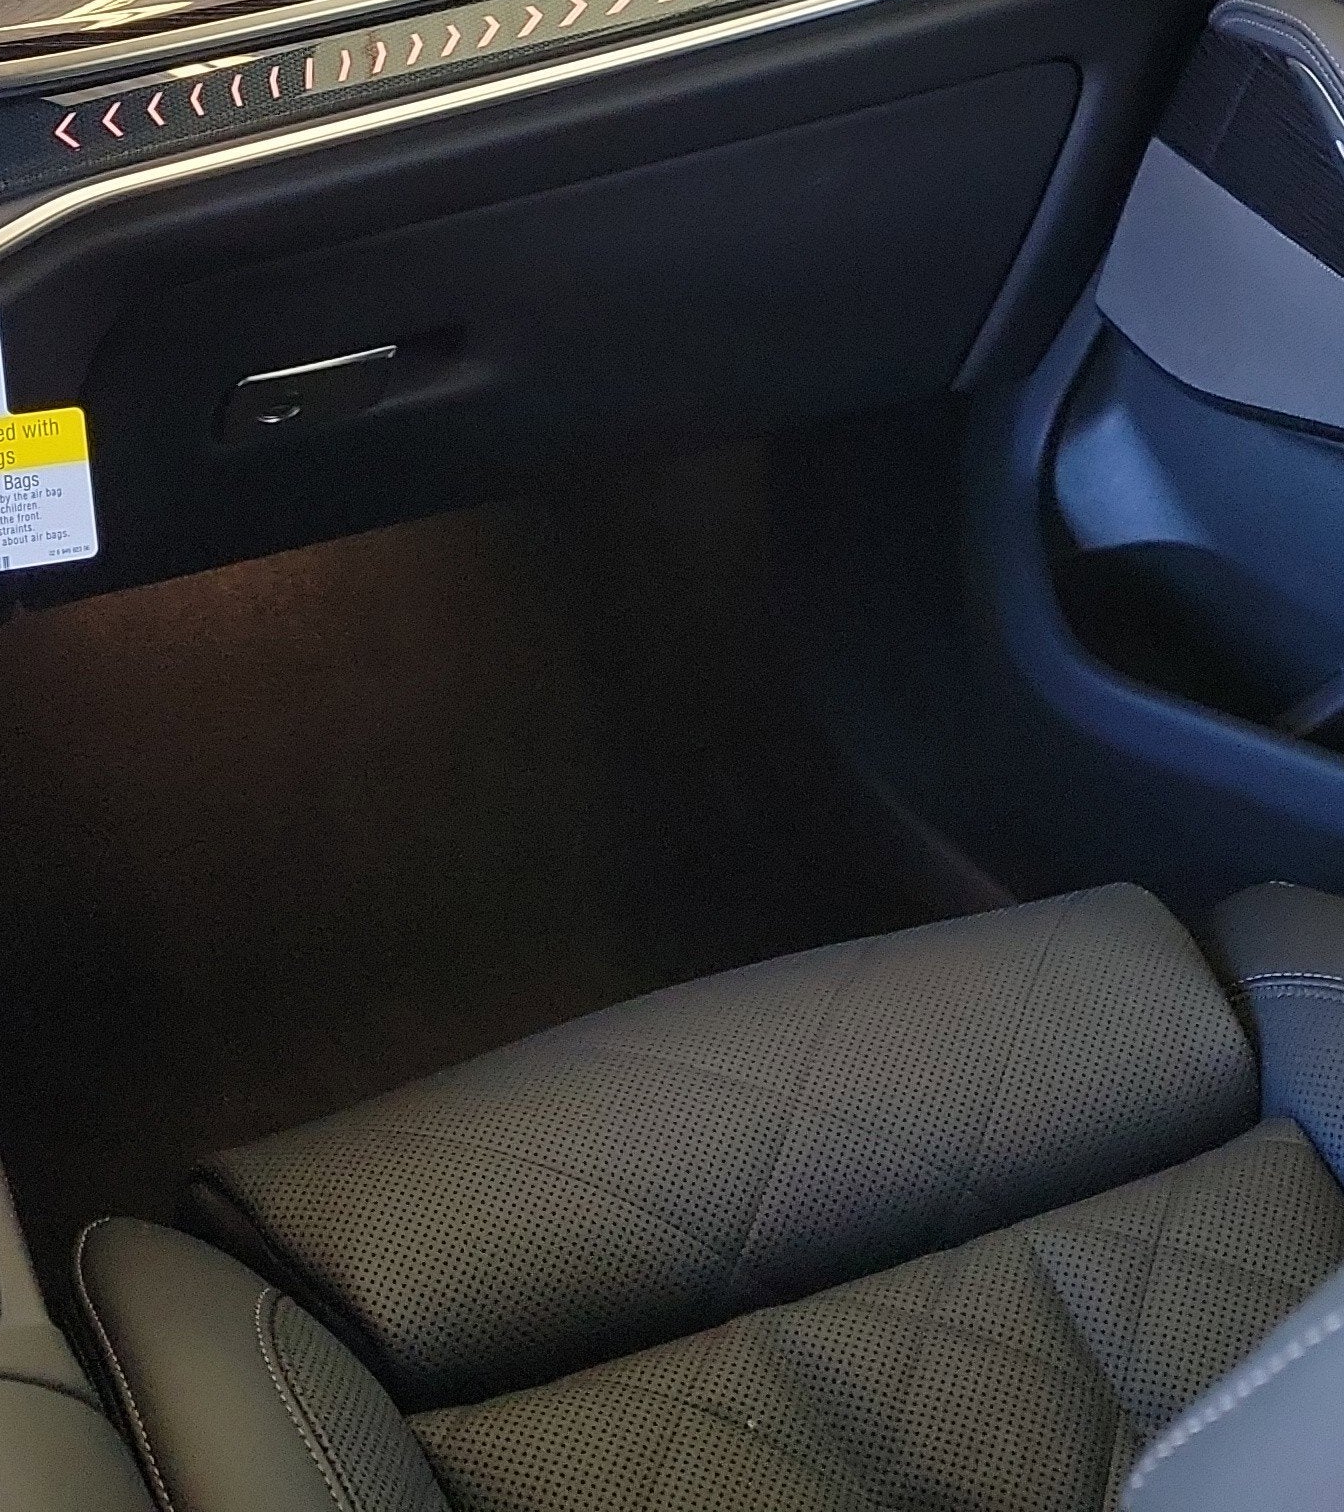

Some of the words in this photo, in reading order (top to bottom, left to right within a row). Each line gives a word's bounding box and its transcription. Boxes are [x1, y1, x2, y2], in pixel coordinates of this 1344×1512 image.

[21, 418, 59, 438] with
[4, 474, 40, 492] Bags
[0, 493, 12, 505] by
[14, 491, 28, 502] the
[30, 489, 43, 499] air
[45, 487, 63, 498] bag
[0, 514, 14, 525] the
[2, 534, 29, 547] about
[31, 531, 43, 543] air
[46, 529, 71, 541] bags.
